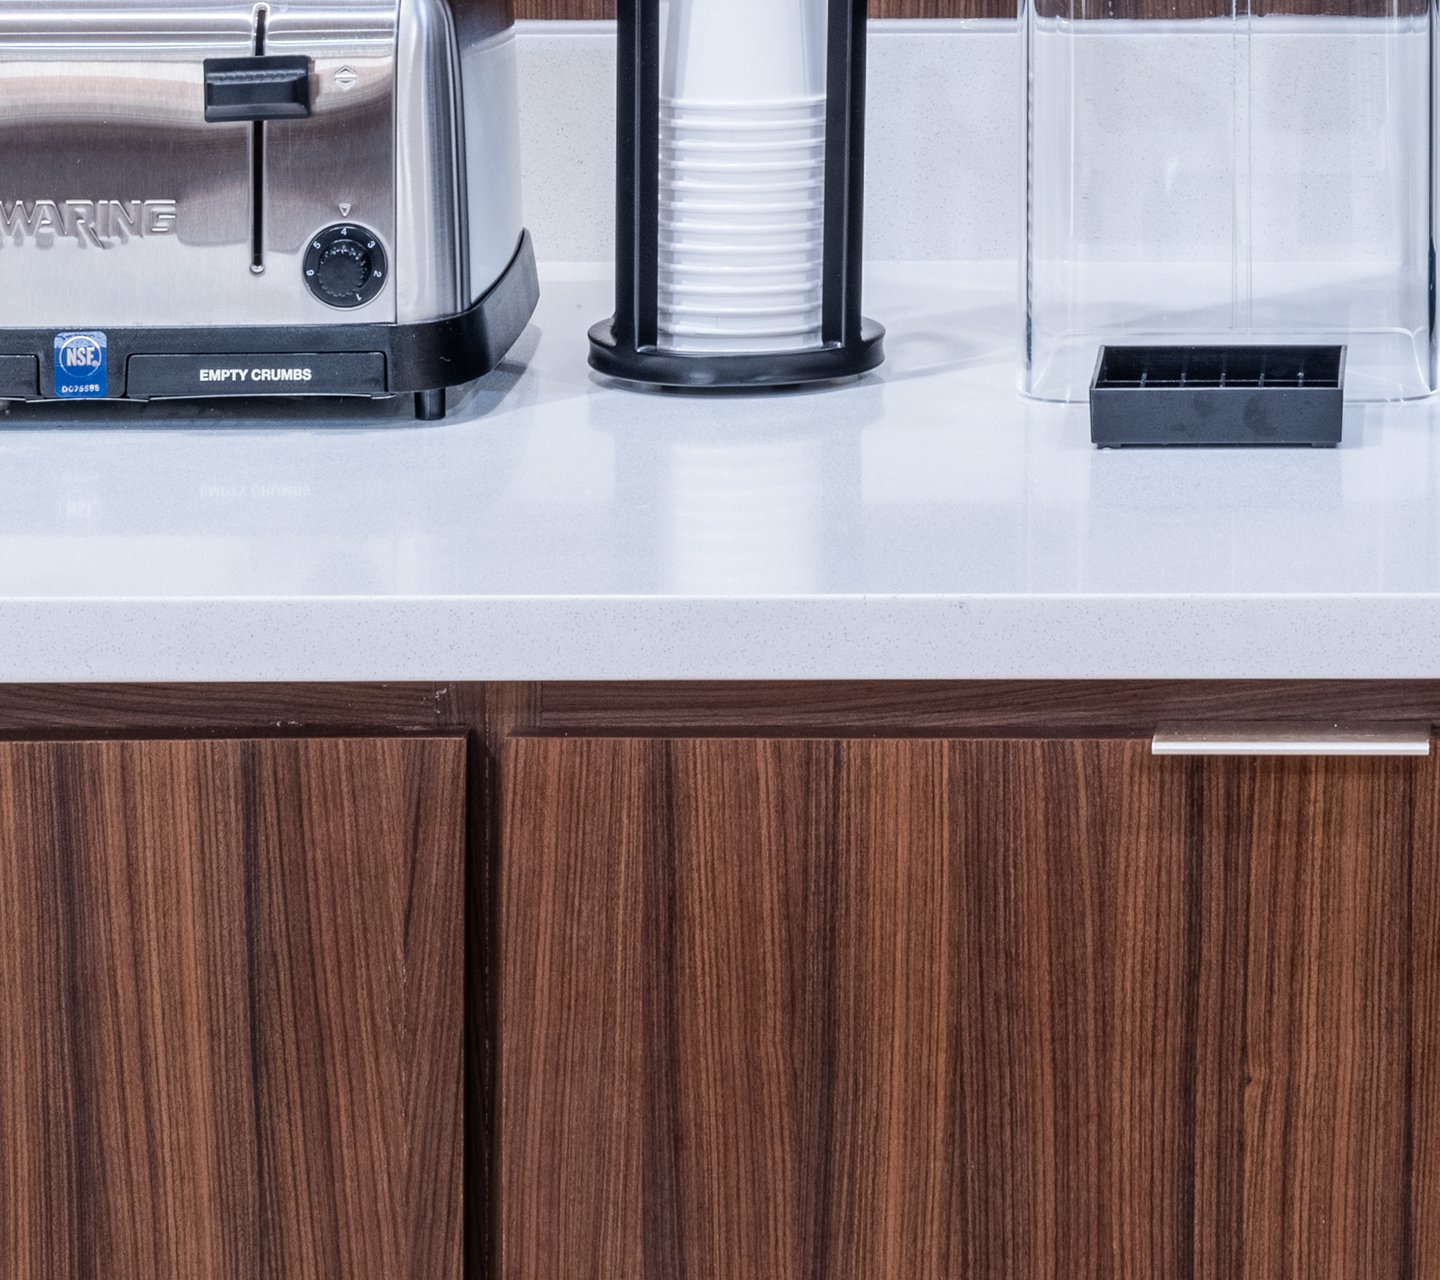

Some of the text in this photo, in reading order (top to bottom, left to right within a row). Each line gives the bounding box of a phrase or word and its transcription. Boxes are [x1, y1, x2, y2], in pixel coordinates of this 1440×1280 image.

[340, 227, 347, 236] 4
[313, 241, 321, 249] 5
[367, 240, 376, 249] 3
[373, 270, 382, 278] 2
[66, 347, 95, 367] NSF
[199, 368, 312, 381] EMPTY CRUMBS
